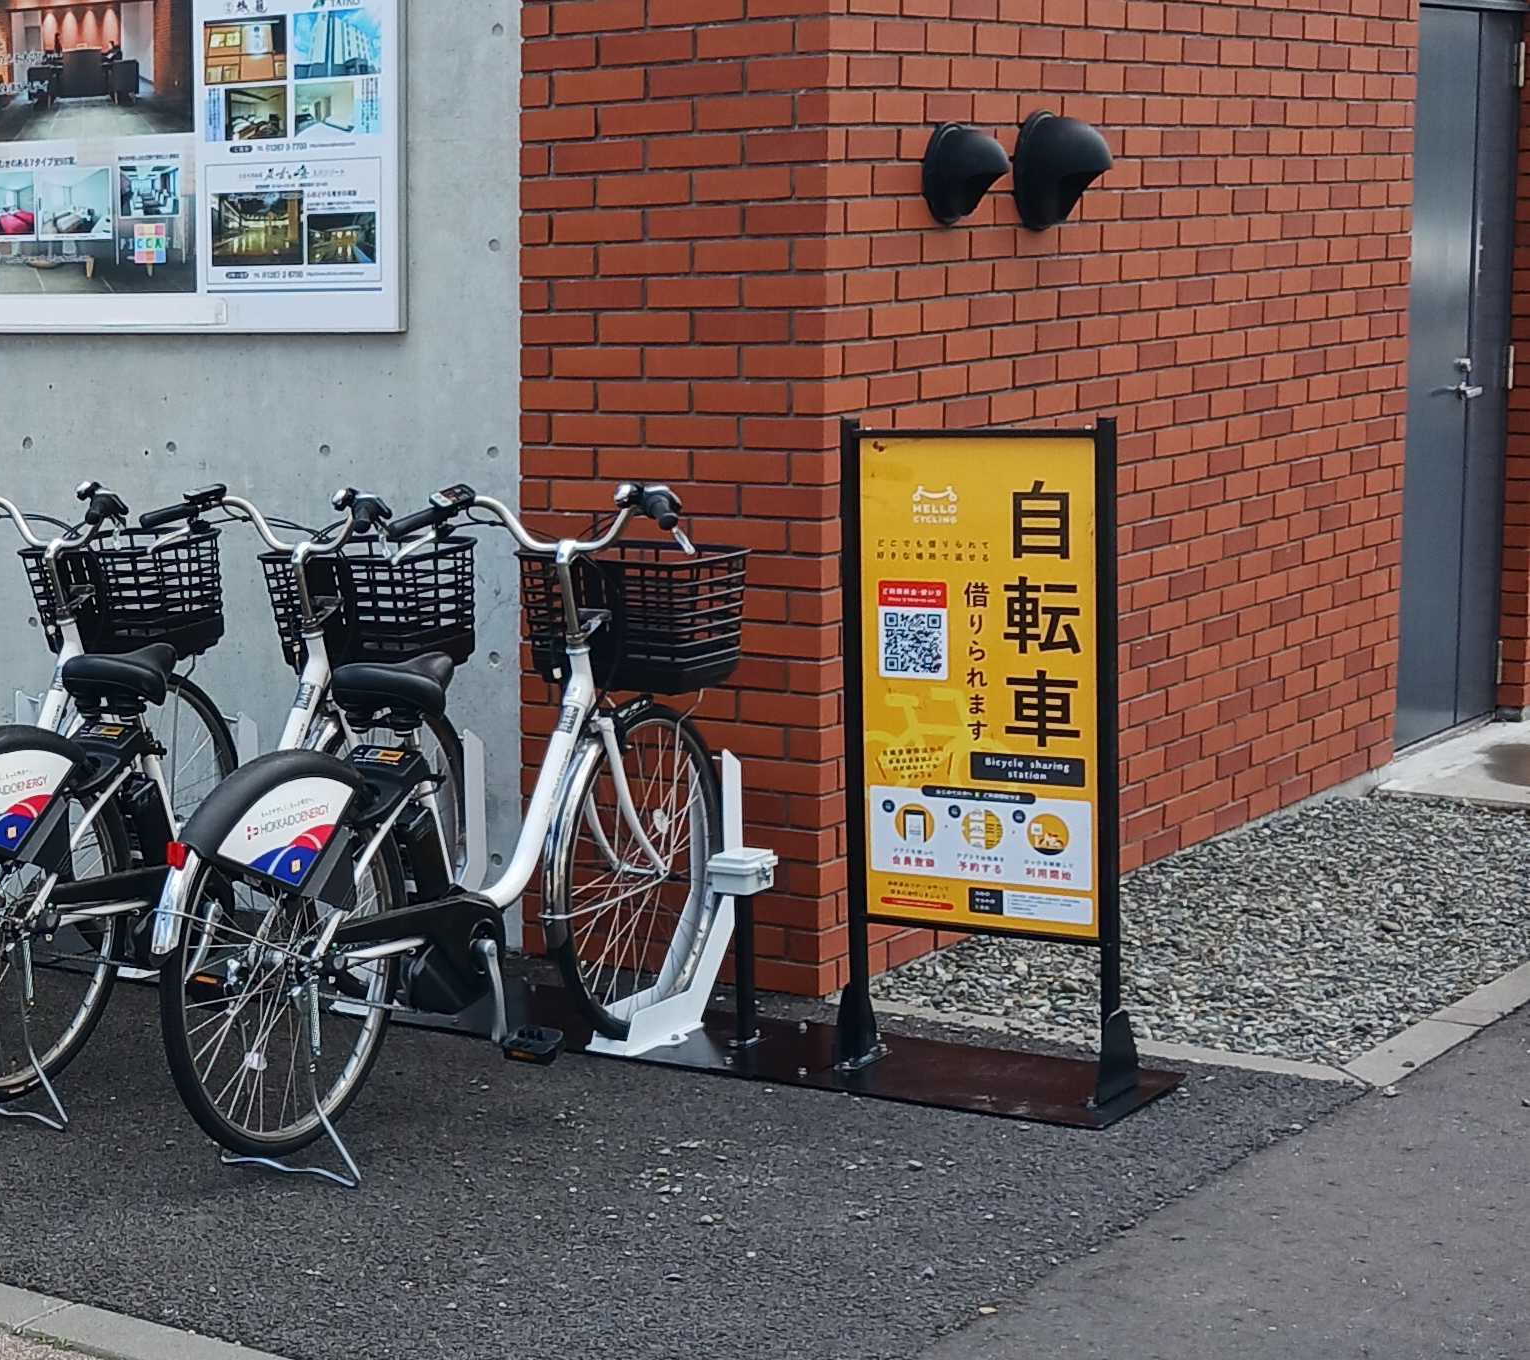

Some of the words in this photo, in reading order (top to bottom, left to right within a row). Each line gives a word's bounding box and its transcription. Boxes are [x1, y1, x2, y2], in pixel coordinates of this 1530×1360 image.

[912, 504, 958, 514] HELLO
[912, 514, 958, 524] CYCLING
[1003, 480, 1082, 748] 自転車
[964, 581, 990, 741] 借りられます
[984, 757, 1024, 770] Bicycle
[1030, 760, 1070, 773] sharing
[1008, 769, 1047, 780] station
[892, 855, 935, 868] 会員登録
[958, 861, 1002, 875] 予約する
[1025, 868, 1072, 881] 利用開始
